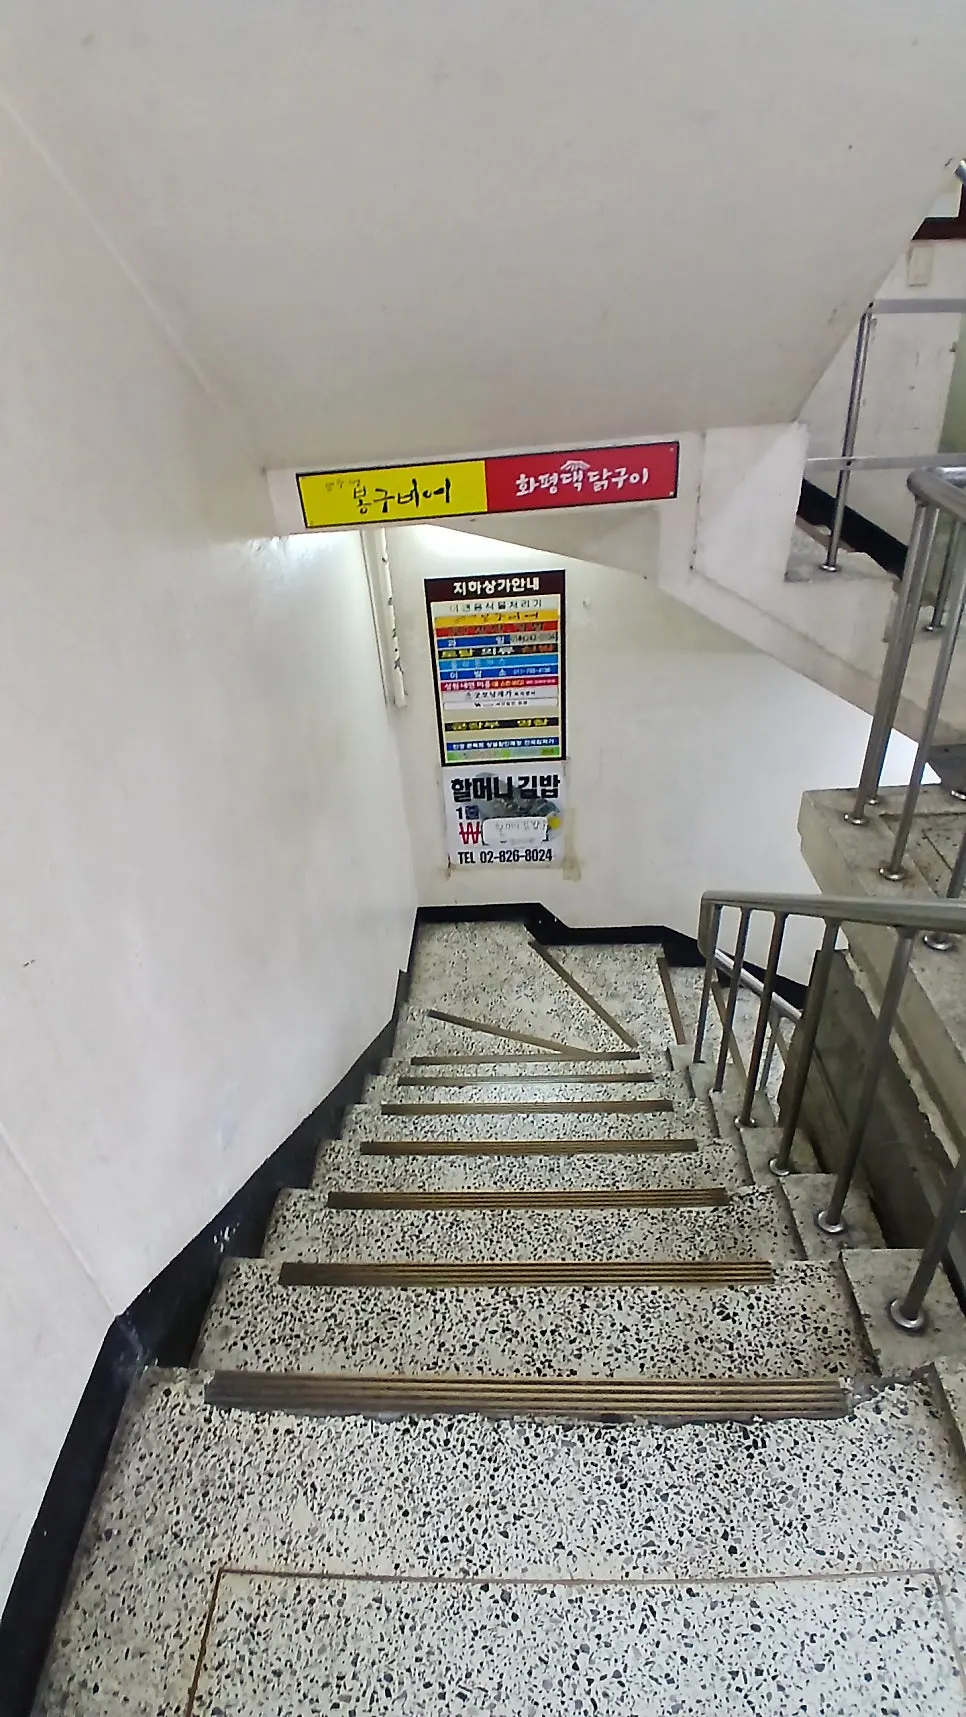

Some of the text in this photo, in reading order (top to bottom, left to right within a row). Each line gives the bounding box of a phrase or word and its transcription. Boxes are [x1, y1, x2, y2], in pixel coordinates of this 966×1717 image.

[351, 477, 452, 515] 봉구비어
[515, 467, 651, 497] 화평댁 닭구이
[453, 576, 540, 596] 지하상가안내
[450, 774, 561, 802] 할머니 김밥
[457, 849, 553, 864] TEL 02-826-8024
